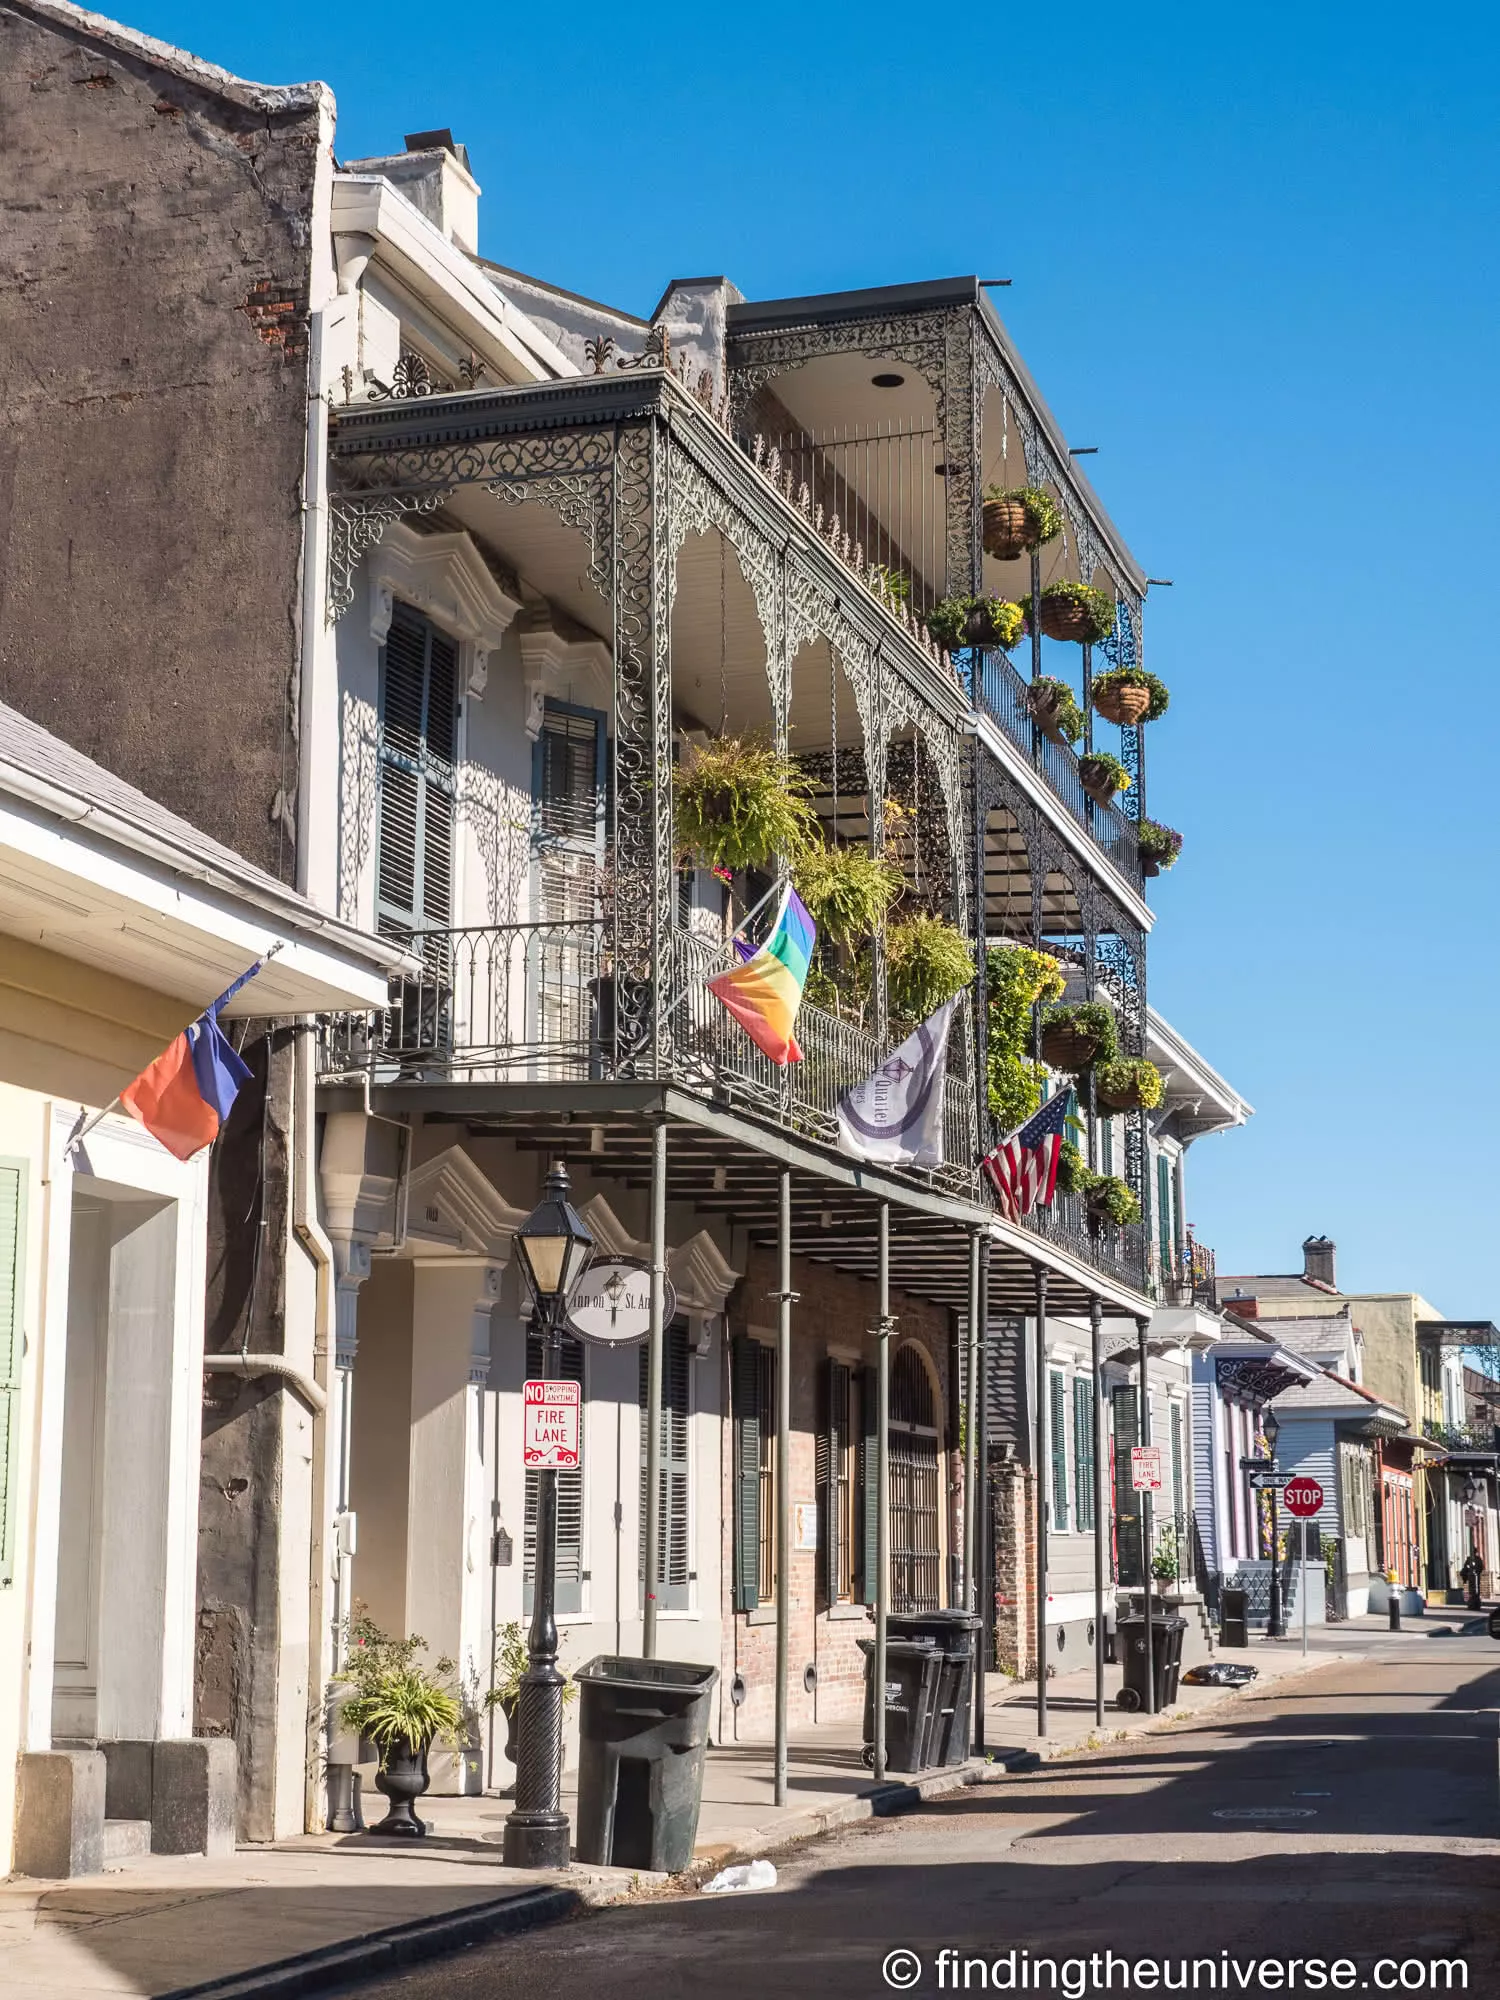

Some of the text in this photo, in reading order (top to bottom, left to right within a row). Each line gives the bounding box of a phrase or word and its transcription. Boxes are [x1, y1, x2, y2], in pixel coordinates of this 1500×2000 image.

[638, 1293, 650, 1309] An
[526, 1385, 544, 1402] NO
[547, 1394, 575, 1402] ANYTIME
[537, 1410, 566, 1424] FIRE
[535, 1428, 567, 1442] LANE
[1286, 1489, 1321, 1505] STOP
